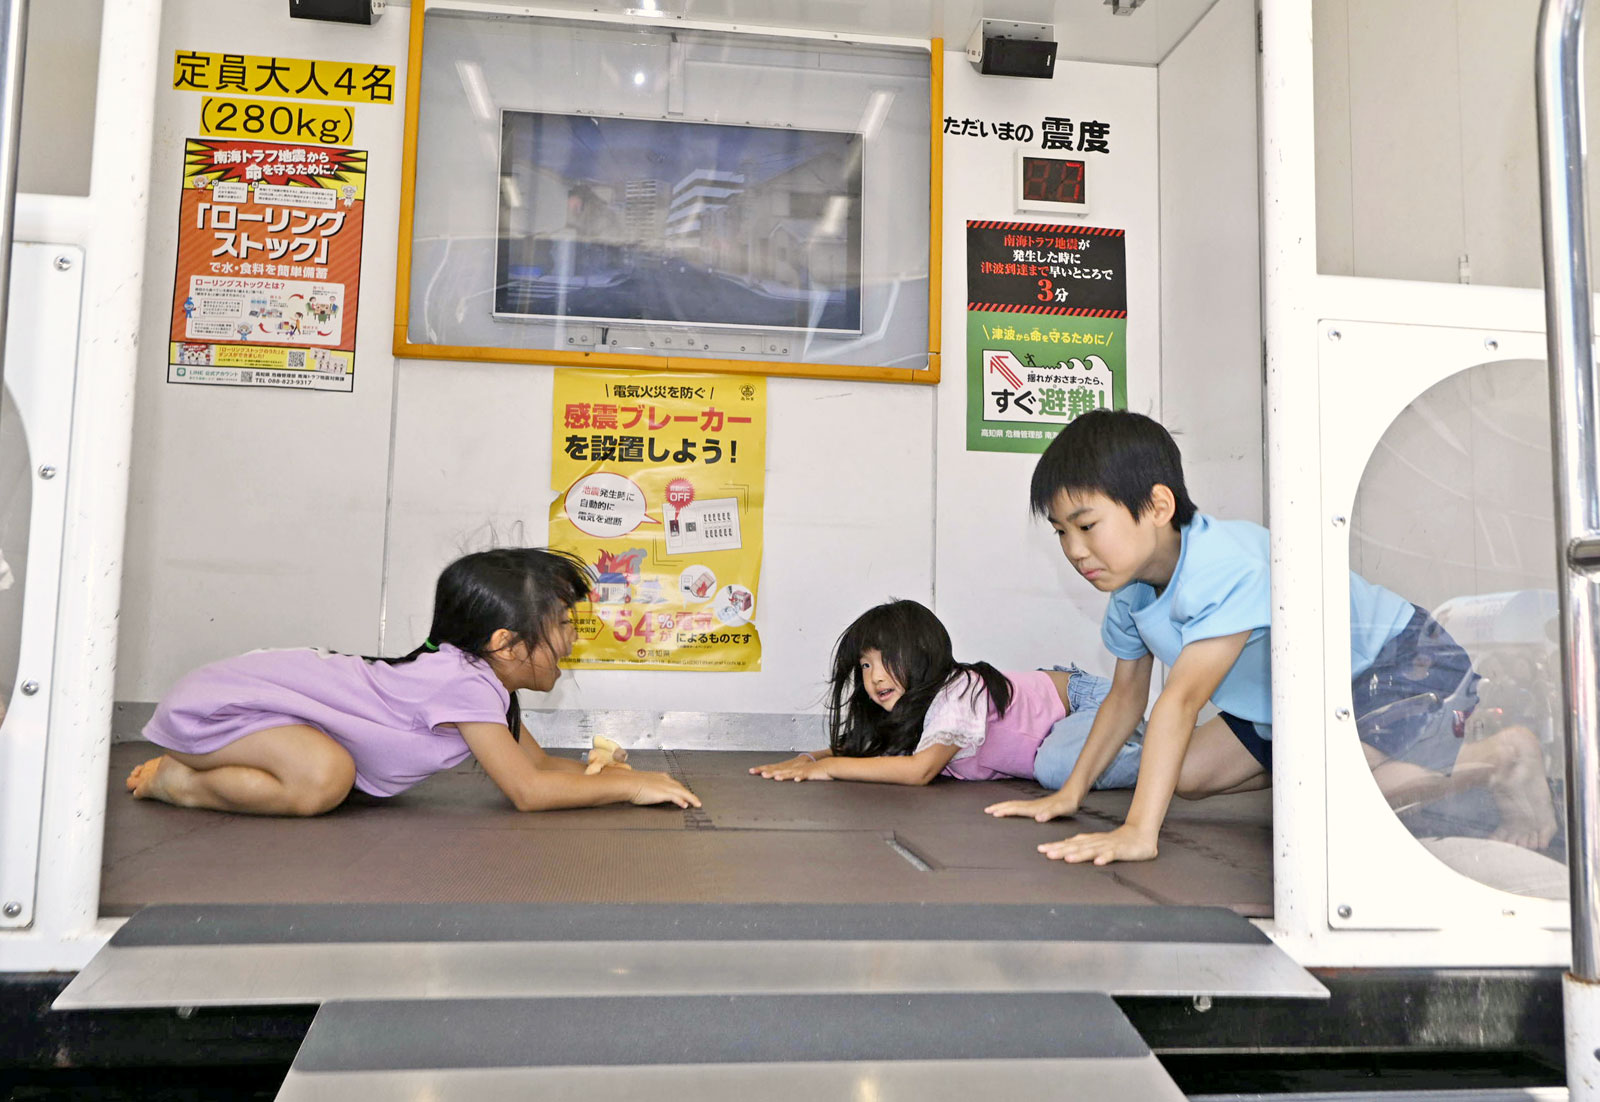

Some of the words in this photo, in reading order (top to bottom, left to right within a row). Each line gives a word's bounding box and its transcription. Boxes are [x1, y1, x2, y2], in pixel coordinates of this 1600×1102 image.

[174, 51, 393, 101] 定員大人4名
[201, 98, 353, 144] (280kg)
[943, 116, 1034, 143] ただいまの
[1041, 116, 1111, 154] 震度
[213, 149, 330, 164] 南海トラフ地震から
[245, 163, 339, 181] 命を守るために!
[197, 203, 346, 237] 「ローリング
[212, 232, 329, 264] ストック」
[1003, 234, 1091, 251] 南海トラフ地震が
[1012, 249, 1081, 265] 発生した時に
[980, 261, 1114, 281] 津波到達まで早いところで
[1036, 278, 1069, 303] 3分
[991, 327, 1105, 345] 津波から命を守るために
[1027, 373, 1105, 386] 揺れがおさまったら、
[613, 384, 706, 400] 電気火災を防ぐ
[564, 402, 752, 432] 感震ブレーカー
[564, 434, 737, 464] を設置しよう!
[582, 486, 635, 502] 地震発生時に
[669, 492, 691, 502] OFF
[579, 498, 615, 512] 自動的に
[577, 511, 622, 526] 電気を遮断
[676, 633, 752, 644] によるものです
